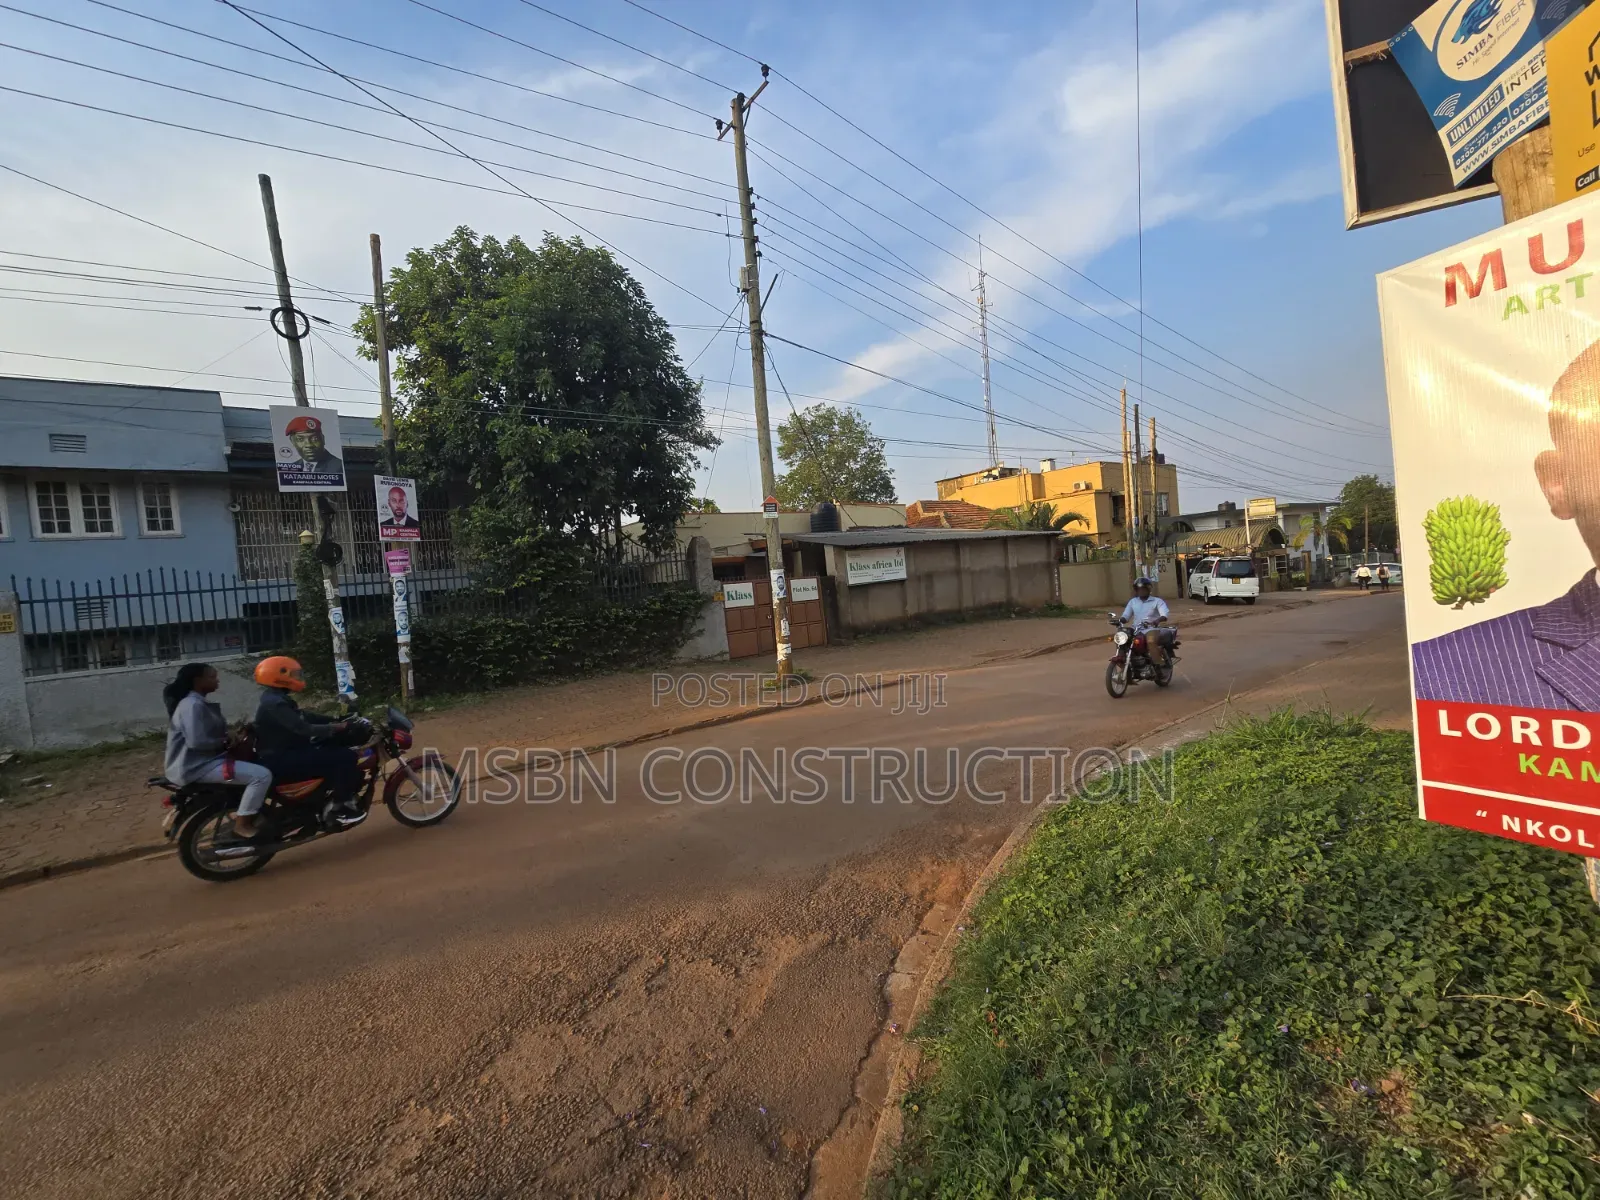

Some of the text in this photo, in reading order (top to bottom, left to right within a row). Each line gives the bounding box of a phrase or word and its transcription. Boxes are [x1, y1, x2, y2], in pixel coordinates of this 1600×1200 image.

[1456, 0, 1527, 70] SIMBA FIBER
[1449, 89, 1501, 142] UNLIMITED
[1455, 117, 1508, 166] 0200-777-220
[1577, 142, 1596, 158] Use
[1577, 171, 1595, 188] Call
[1502, 272, 1593, 321] ART
[383, 528, 397, 536] MP
[849, 558, 904, 571] Klass africa ltd
[726, 590, 752, 601] Klass
[1438, 709, 1592, 750] LORD
